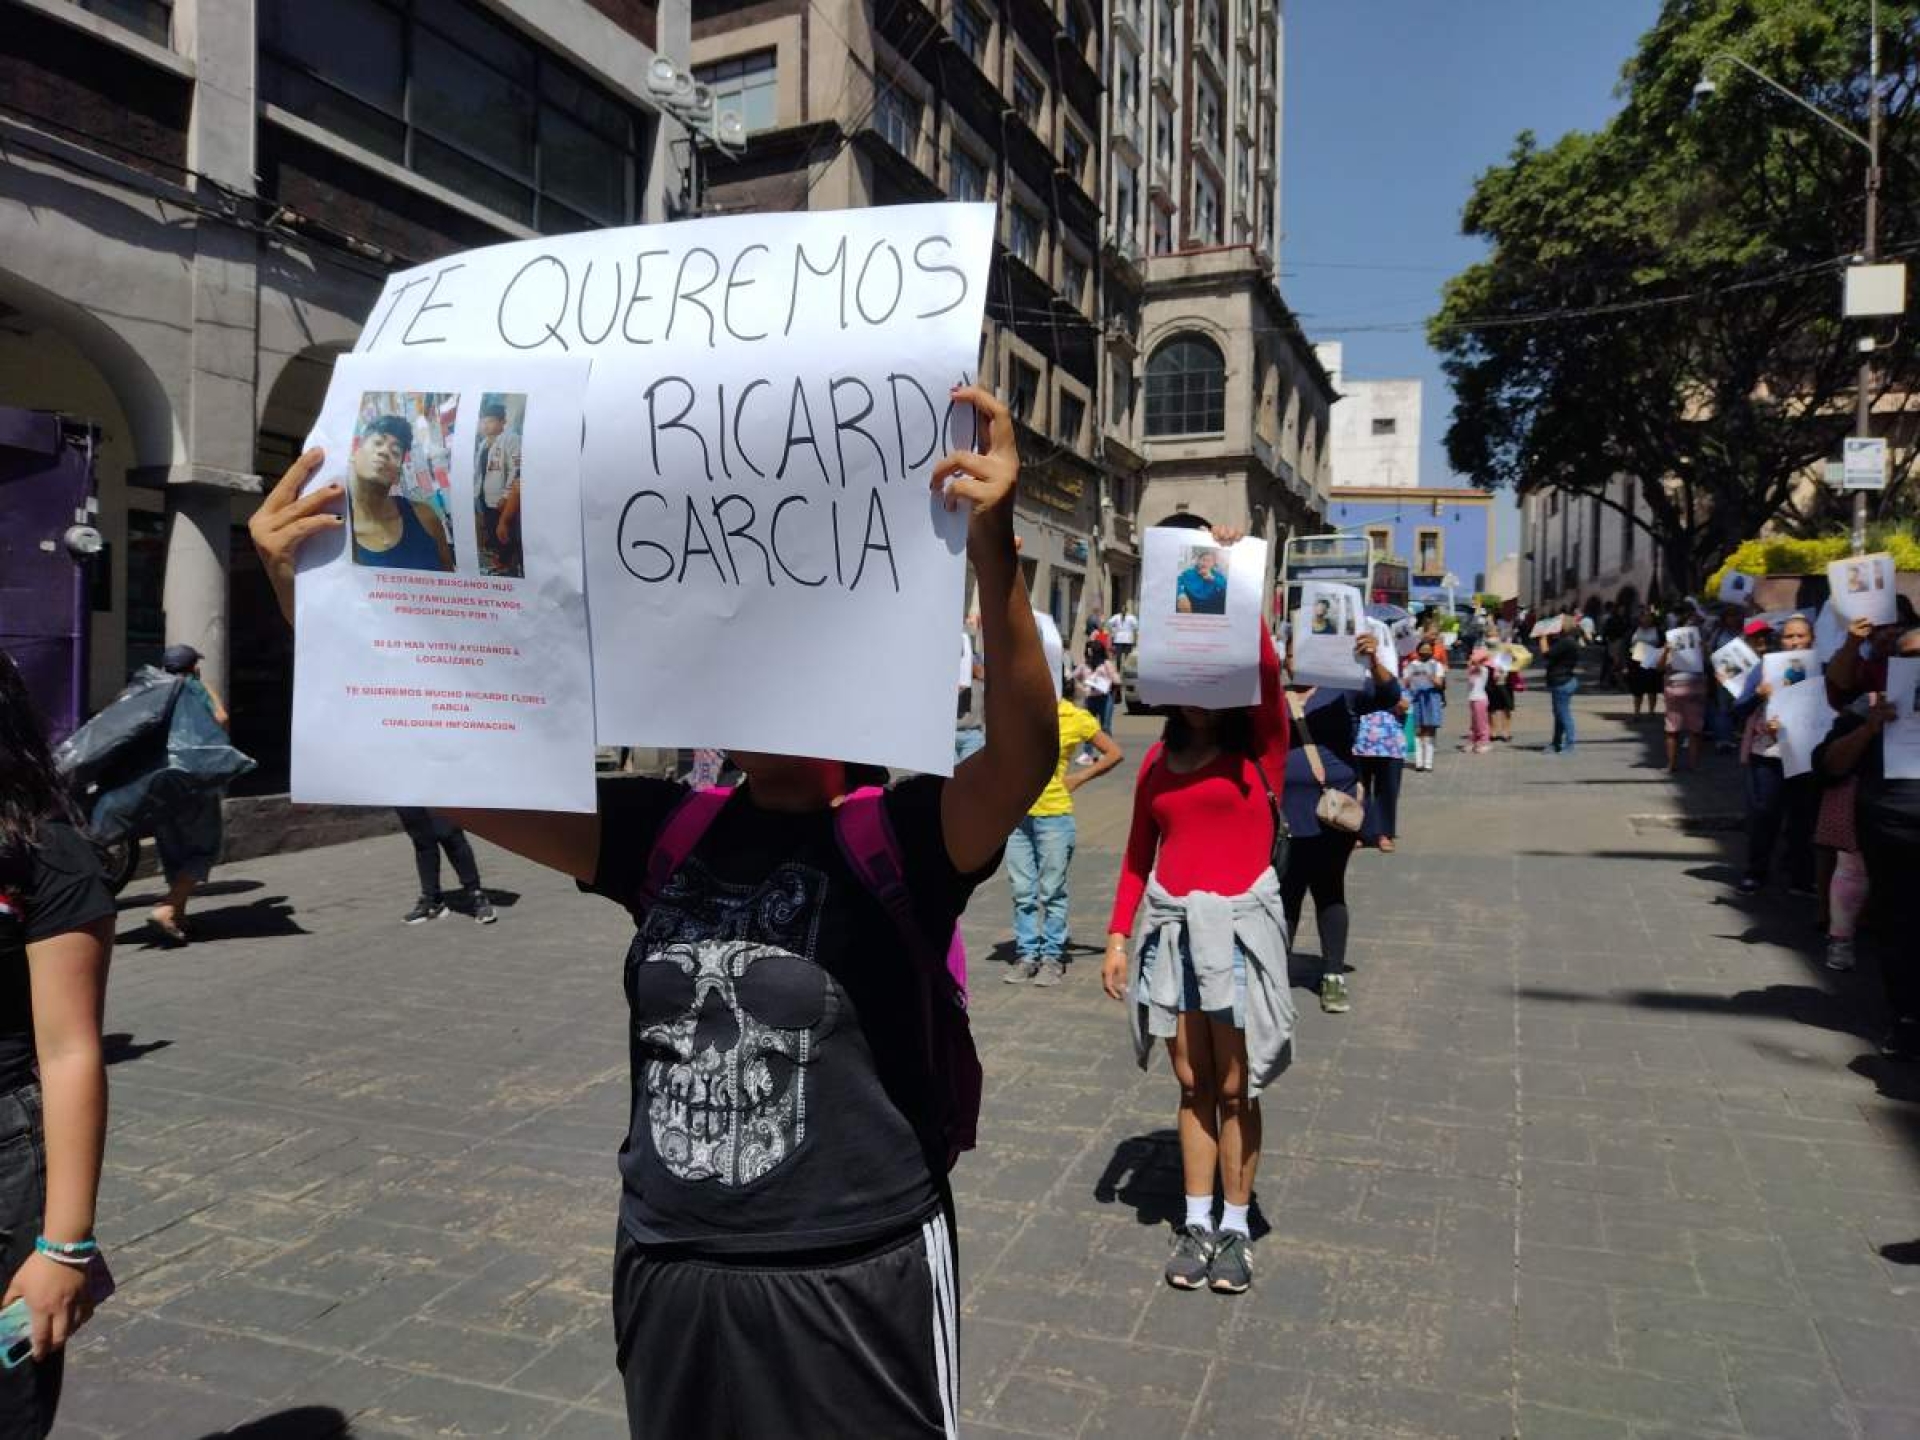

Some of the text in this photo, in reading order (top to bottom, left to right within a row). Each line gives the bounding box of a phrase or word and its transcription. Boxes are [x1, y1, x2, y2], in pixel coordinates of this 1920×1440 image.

[366, 235, 969, 353] TE QUEREMOS
[643, 371, 977, 487] RICARDO
[616, 488, 900, 592] GARCIA
[390, 575, 435, 586] ESTAMOS
[437, 579, 489, 590] BUSCANDO
[368, 591, 409, 601] AMIGOS
[419, 594, 476, 606] FAMILIARES
[478, 599, 521, 609] ESTAMOS
[394, 605, 466, 618] PREOCUPADOS
[468, 611, 487, 619] POR
[361, 687, 422, 697] QUEREMOS
[425, 690, 462, 699] MUCHO
[465, 691, 509, 702] RICARDO
[381, 719, 516, 731] CUALQUIER INFORMACION
